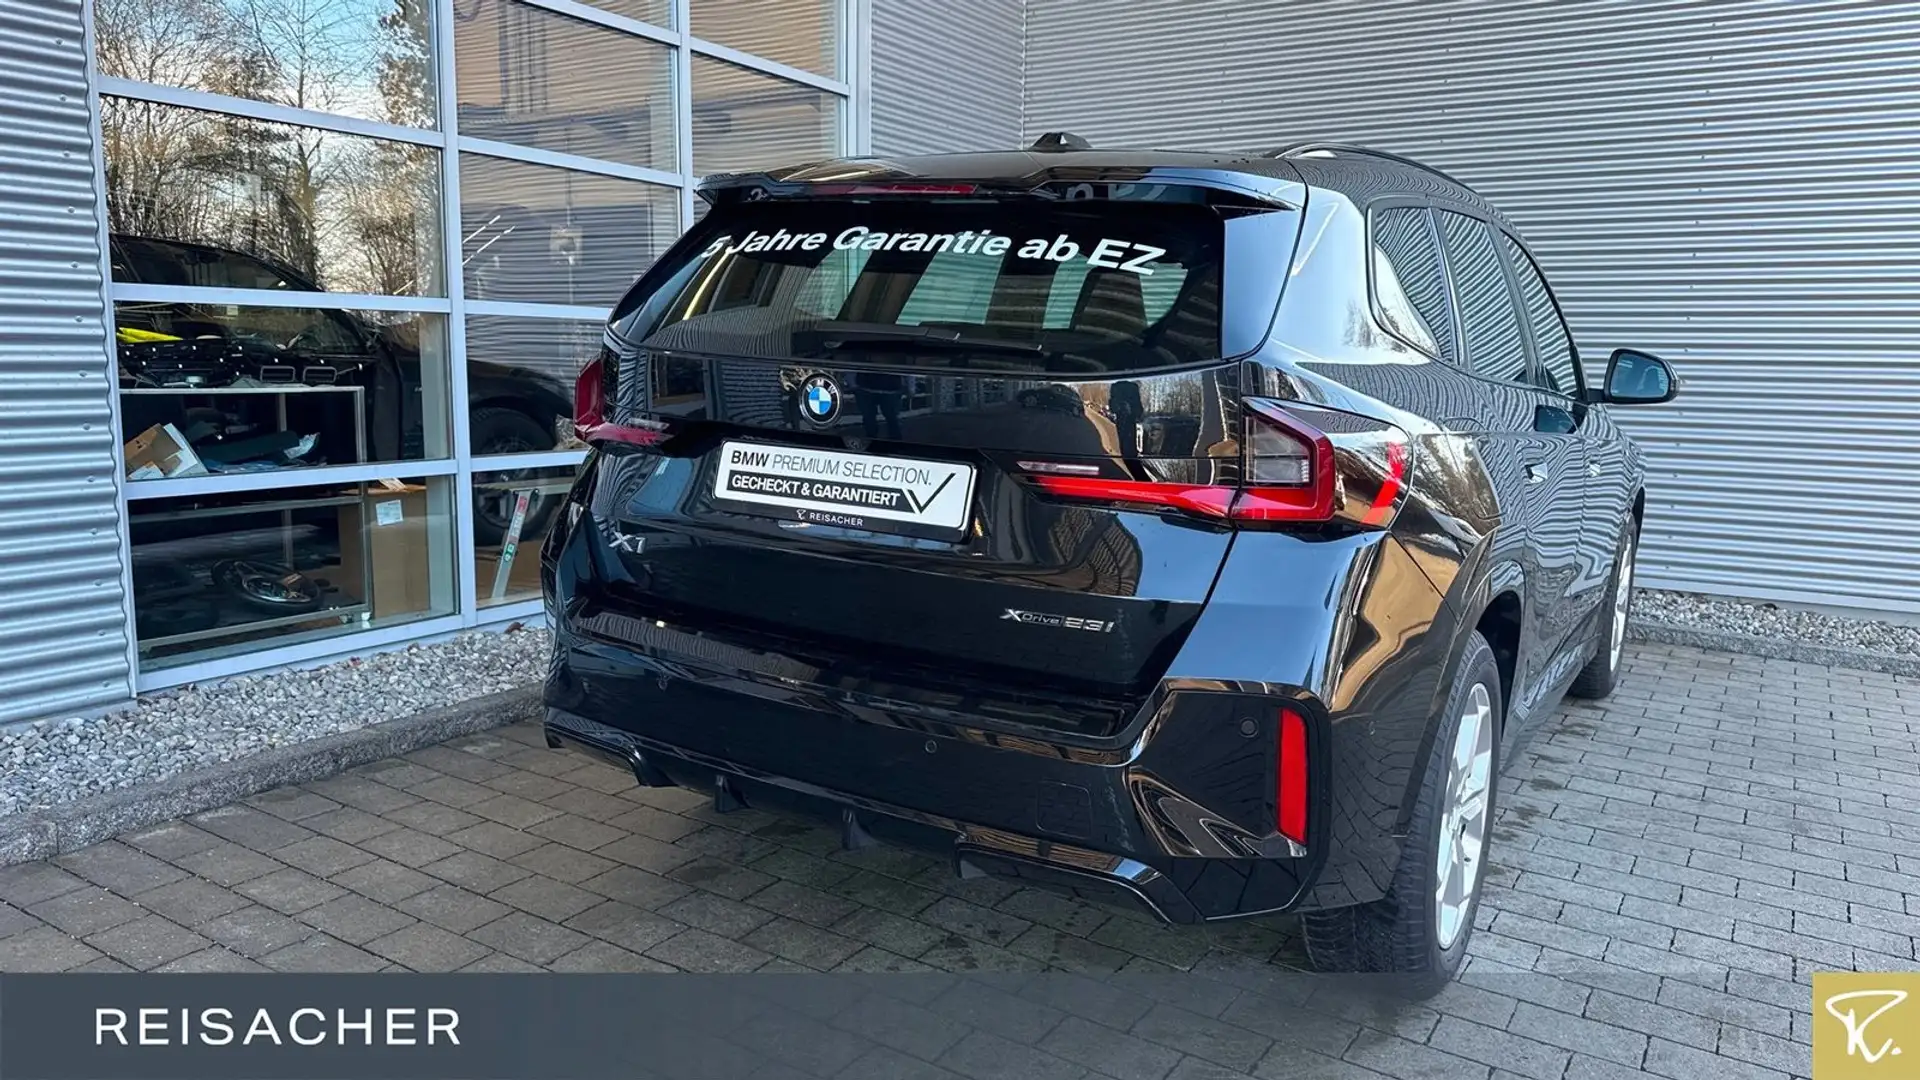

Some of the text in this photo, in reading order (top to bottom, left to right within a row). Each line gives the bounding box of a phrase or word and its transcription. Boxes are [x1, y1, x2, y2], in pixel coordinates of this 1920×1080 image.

[700, 225, 1167, 276] 5 Jahre Garantie ab EZ
[731, 450, 769, 468] BMW
[772, 454, 840, 477] PREMIUM
[732, 474, 900, 507] GECHECKT & GARANTIERT
[809, 512, 864, 527] REISACHER
[608, 531, 646, 554] X1
